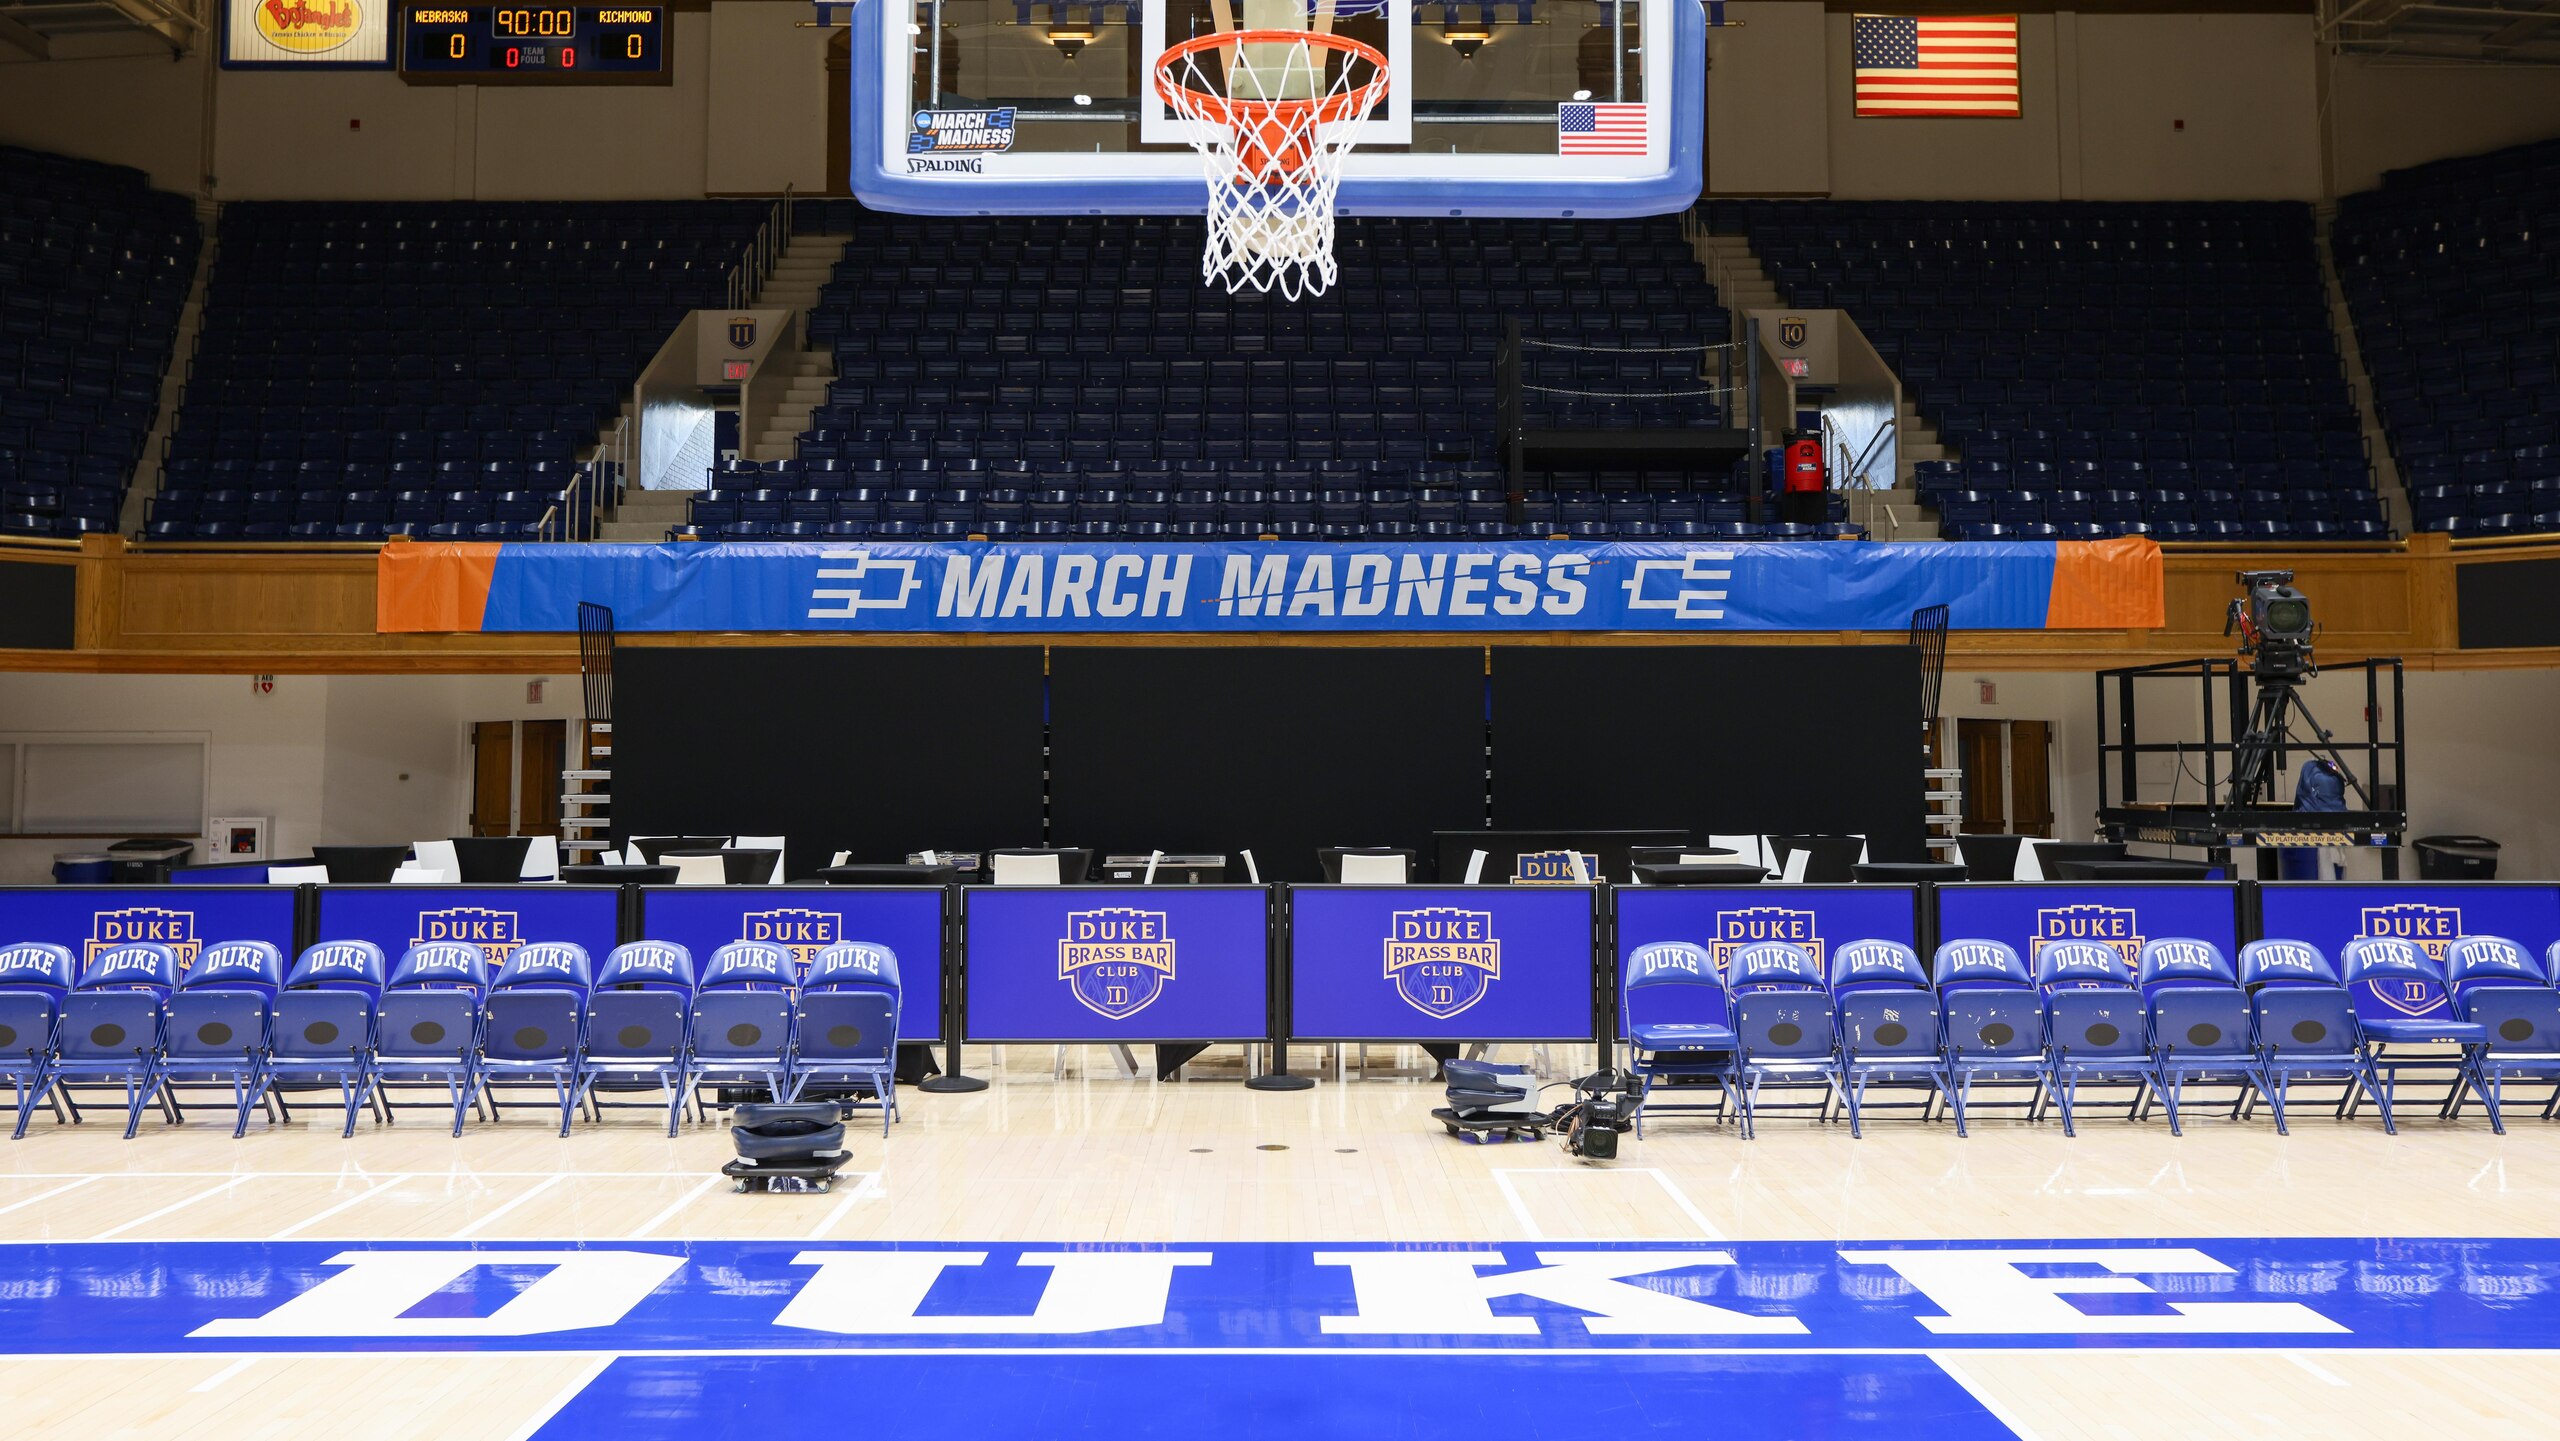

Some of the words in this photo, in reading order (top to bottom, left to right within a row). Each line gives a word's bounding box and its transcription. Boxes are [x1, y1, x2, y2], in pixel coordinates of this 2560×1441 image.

[415, 10, 468, 23] NEBRASKA
[498, 10, 571, 35] 90:00
[599, 10, 652, 23] RICHMOND
[450, 33, 465, 59] 0
[523, 47, 544, 55] TEAM
[627, 33, 642, 59] 0
[506, 47, 519, 68] 0
[520, 55, 546, 64] FOULS
[562, 47, 575, 68] 0
[931, 113, 987, 129] MARCH
[938, 128, 1012, 145] MADNESS
[907, 158, 982, 174] SPALDING
[735, 326, 750, 343] 11
[1784, 325, 1803, 342] 10
[727, 363, 750, 379] EXIT
[935, 554, 1193, 618] MARCH
[1217, 553, 1592, 617] MADNESS
[1527, 862, 1589, 877] DUK
[105, 921, 183, 940] DUKE
[430, 921, 507, 940] DUKE
[754, 922, 832, 941] DUKE
[1078, 921, 1156, 940] DUKE
[1404, 921, 1481, 940] DUKE
[1728, 920, 1805, 939] DUKE
[2049, 918, 2126, 937] DUKE
[2373, 917, 2451, 936] DUKE
[0, 948, 56, 976] DUKE
[101, 949, 160, 977] DUKE
[205, 946, 264, 974] DUKE
[309, 946, 367, 974] DUKE
[413, 946, 472, 974] DUKE
[517, 947, 573, 974] DUKE
[619, 947, 677, 975] DUKE
[722, 948, 778, 974] DUKE
[825, 948, 880, 976] DUKE
[1068, 946, 1126, 967] BRASS
[1132, 946, 1168, 967] BAR
[1393, 946, 1451, 966] BRASS
[1457, 946, 1493, 967] BAR
[1642, 948, 1699, 976] DUKE
[1745, 948, 1800, 976] DUKE
[1849, 945, 1905, 973] DUKE
[1950, 945, 2006, 972] DUKE
[2053, 945, 2110, 973] DUKE
[2154, 943, 2212, 971] DUKE
[2255, 945, 2313, 973] DUKE
[2357, 942, 2417, 970] DUKE
[2461, 941, 2521, 970] DUKE
[1096, 966, 1138, 977] CLUB
[1421, 965, 1463, 976] CLUB
[184, 1248, 2354, 1338] DUKE
